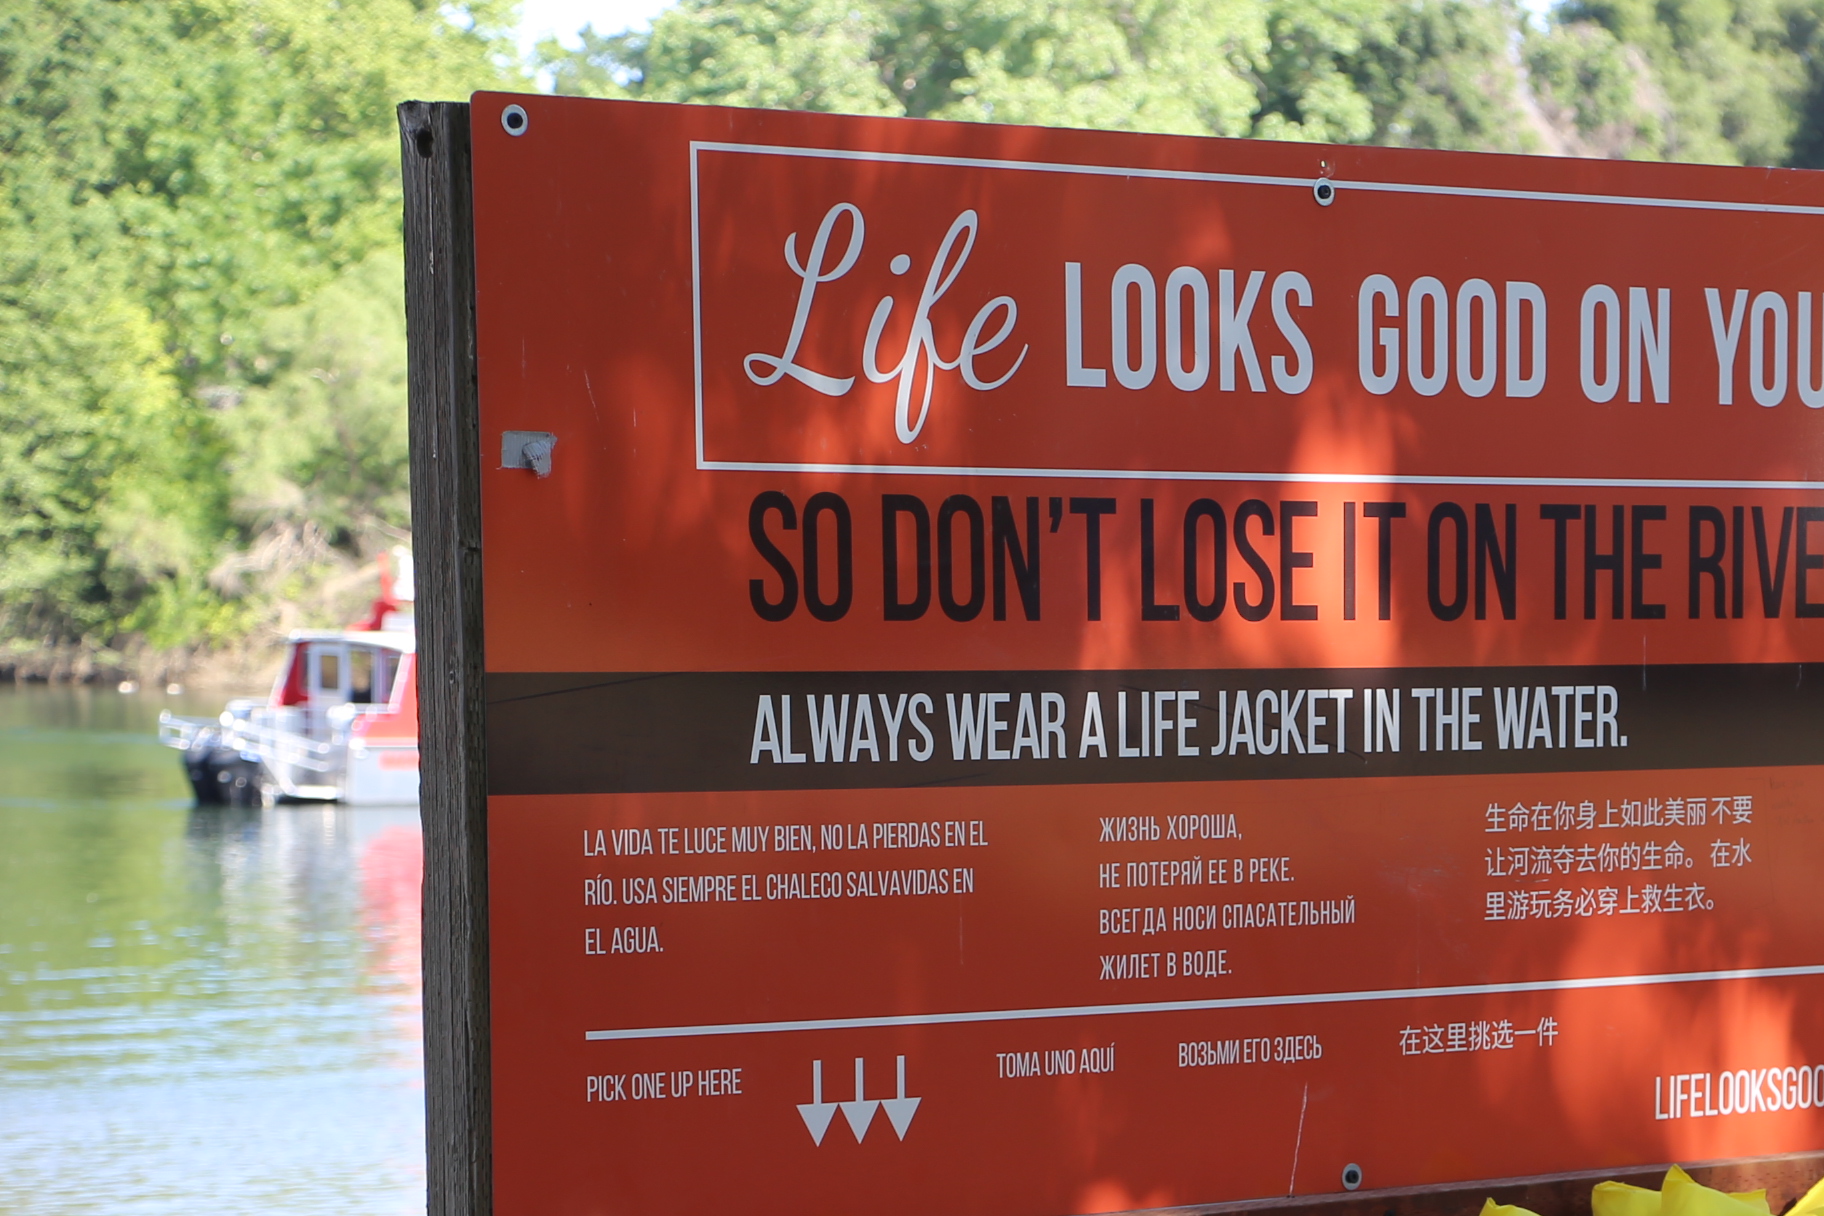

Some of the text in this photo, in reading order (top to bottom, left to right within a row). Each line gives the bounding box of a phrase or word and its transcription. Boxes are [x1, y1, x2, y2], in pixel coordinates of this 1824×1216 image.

[743, 202, 1029, 445] Life
[1064, 261, 1314, 395] LOOKS
[1358, 273, 1547, 398] GOOD
[1580, 284, 1670, 403] ON
[748, 490, 854, 623] SO
[881, 493, 1117, 623] DON'T
[1140, 497, 1318, 623] LOSE
[1342, 500, 1407, 621] IT
[1427, 501, 1517, 622] ON
[1539, 503, 1667, 621] THE
[749, 685, 1628, 764] ALWAYS WEAR A LIFE JACKET IN THE WATER.
[583, 820, 989, 857] LA VIDA TE LUCE MUY BIEN, NO LA PIERDAS EN EL
[1099, 813, 1242, 843] ЖИЗНЬ ХОРОША,
[584, 867, 974, 906] RÍO. USA SIEMPRE EL CHALECO SALVAVIDAS EN
[1099, 855, 1295, 889] НЕ ПОТЕРЯЙ ЕЕ В РЕКЕ.
[1099, 894, 1355, 936] ВСЕГДА НОСИ СПАСАТЕЛЬНЫЙ
[585, 926, 664, 955] EL AGUA.
[1099, 949, 1232, 981] ЖИЛЕТ В ВОДЕ.
[1178, 1034, 1322, 1068] ВОЗЬМИ ЕГО ЗДЕСЬ
[1399, 1016, 1559, 1056] 在这里挑选一件
[995, 1042, 1115, 1079] TOMA UNO AQUÍ
[586, 1067, 743, 1103] PICK ONE UP HERE
